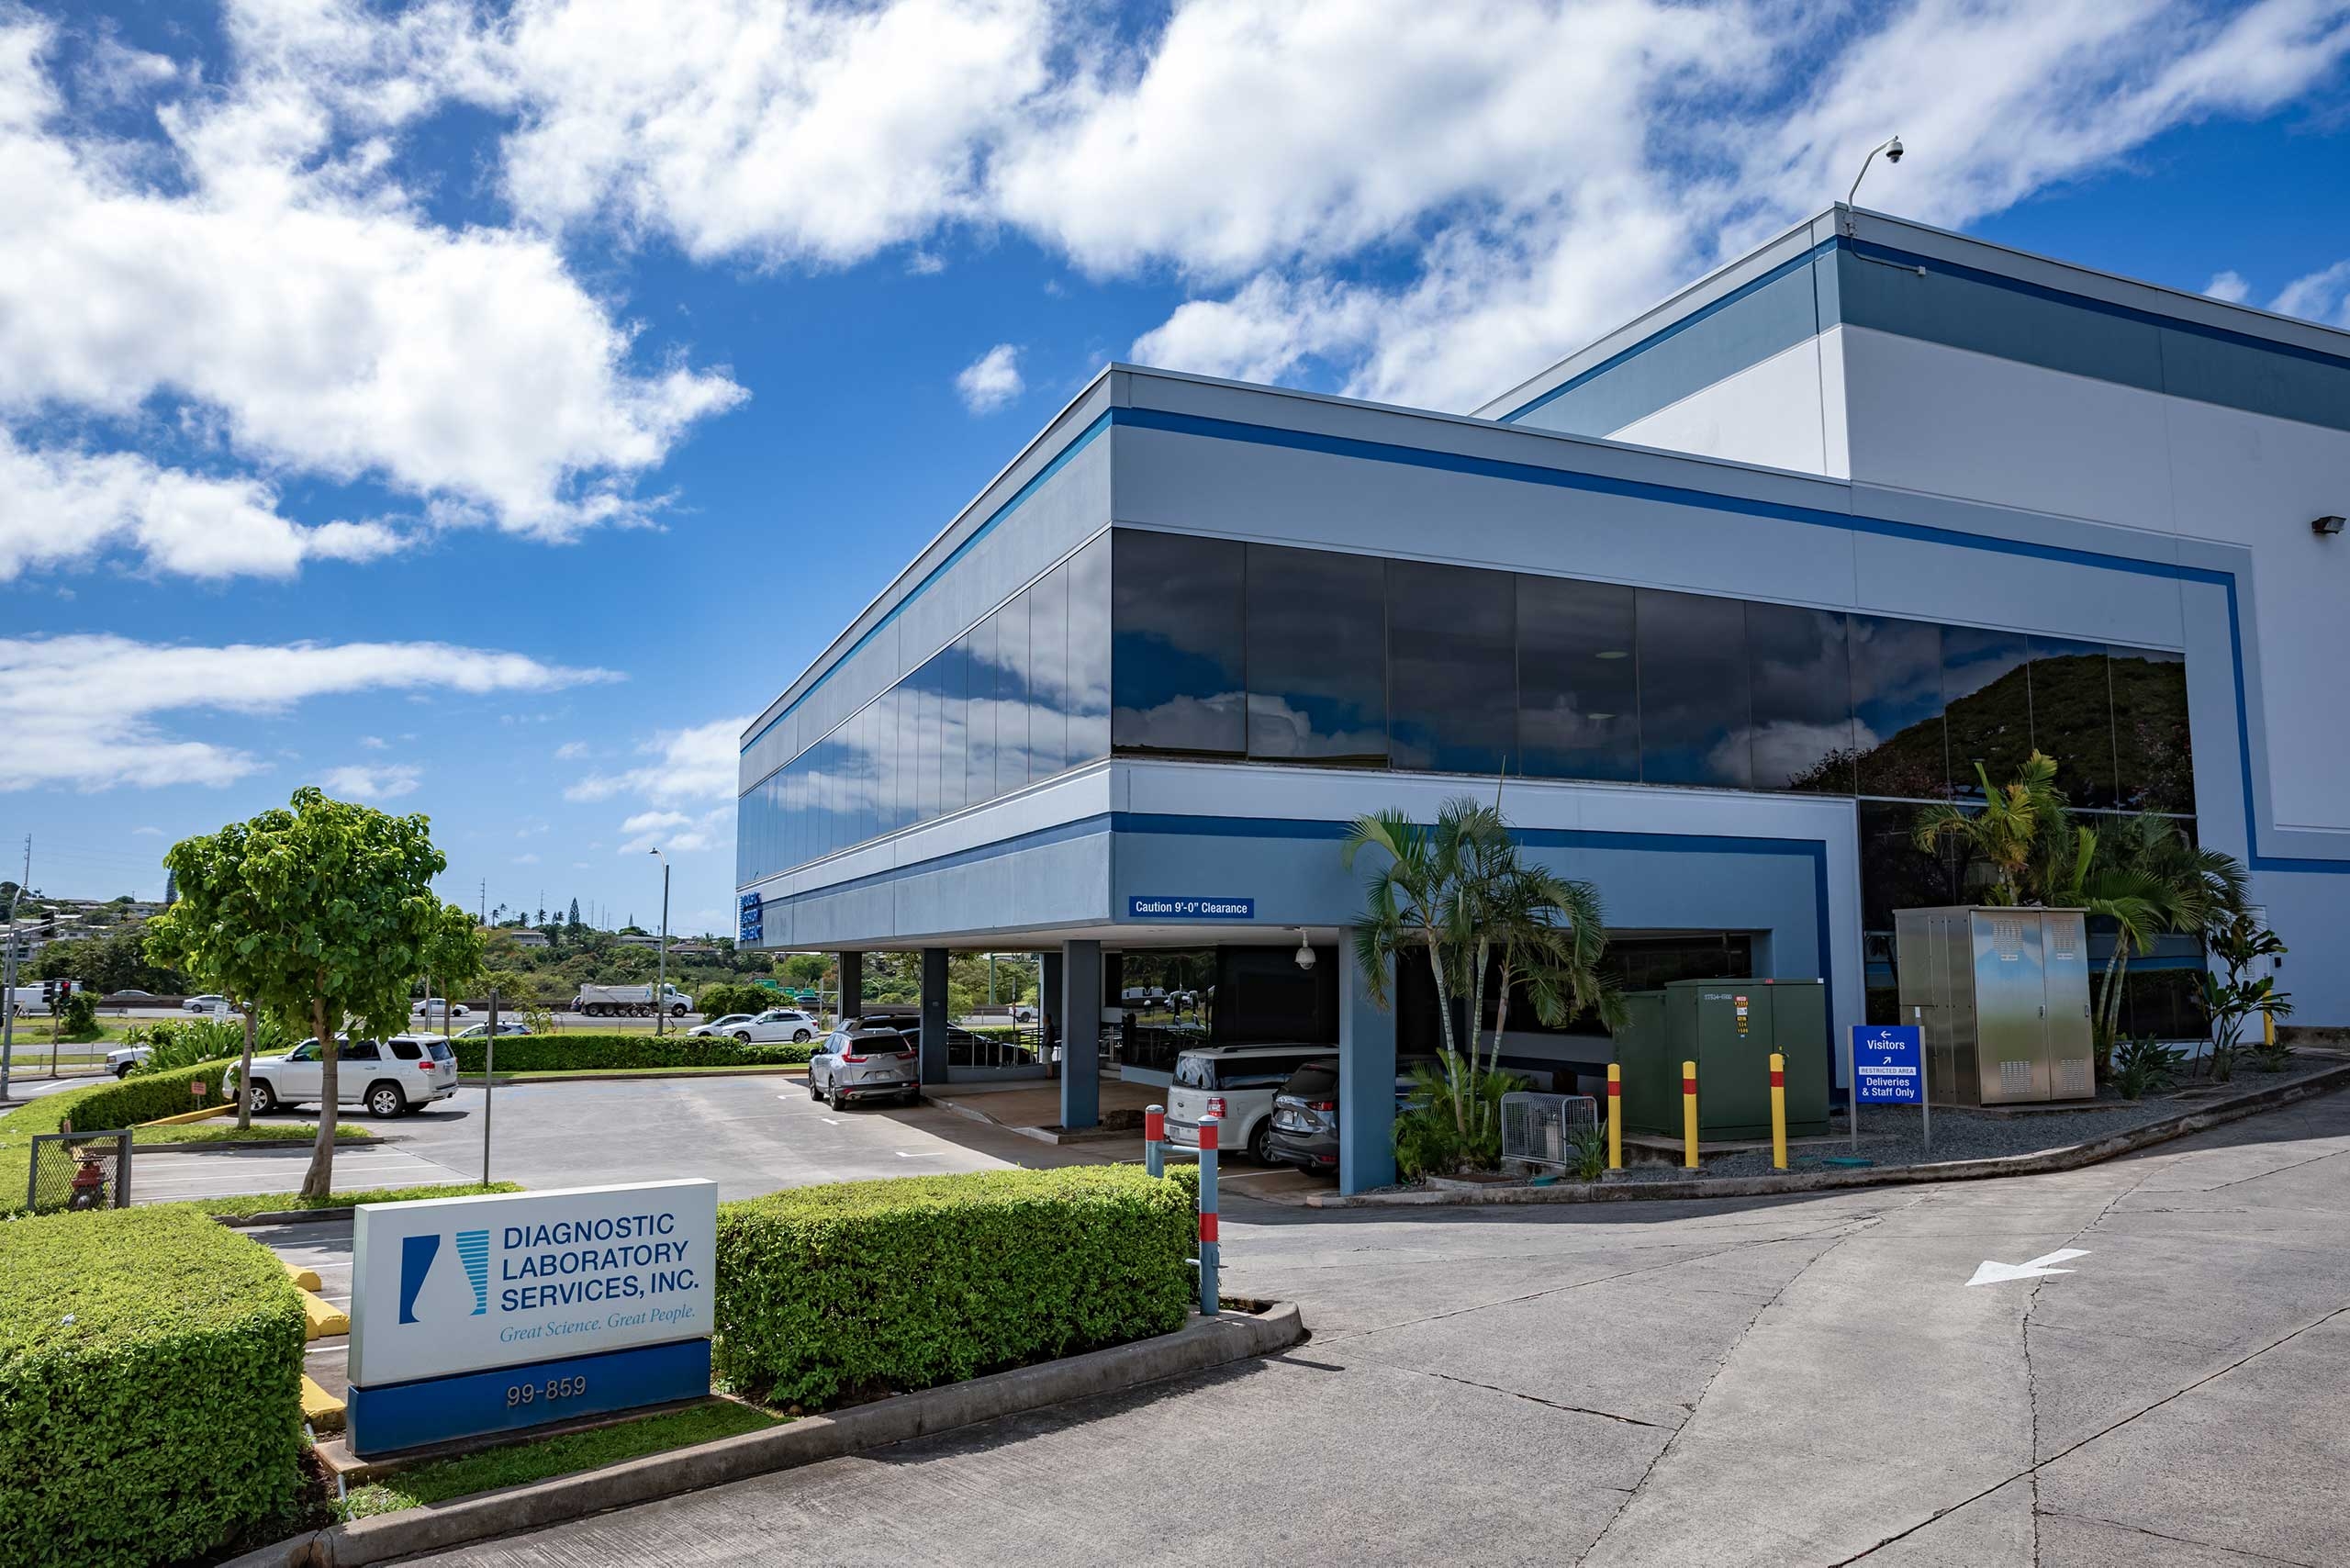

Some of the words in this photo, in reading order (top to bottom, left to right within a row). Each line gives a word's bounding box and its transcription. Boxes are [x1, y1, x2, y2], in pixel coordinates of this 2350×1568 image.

[1136, 901, 1172, 913] Caution
[1201, 902, 1248, 914] Clearance
[1867, 1040, 1906, 1050] Visitors
[1862, 1088, 1869, 1096] &
[1872, 1088, 1893, 1096] Staff
[1895, 1087, 1915, 1099] Only
[1866, 1077, 1909, 1086] Deliveries
[503, 1213, 676, 1250] DIAGNOSTIC
[501, 1240, 689, 1282] LABORATORY
[499, 1274, 646, 1313] SERVICES,
[650, 1269, 700, 1295] INC.
[498, 1319, 543, 1344] Great
[545, 1314, 603, 1338] Science.
[607, 1308, 647, 1329] Great
[650, 1302, 697, 1327] People.
[505, 1375, 588, 1409] 99-859
